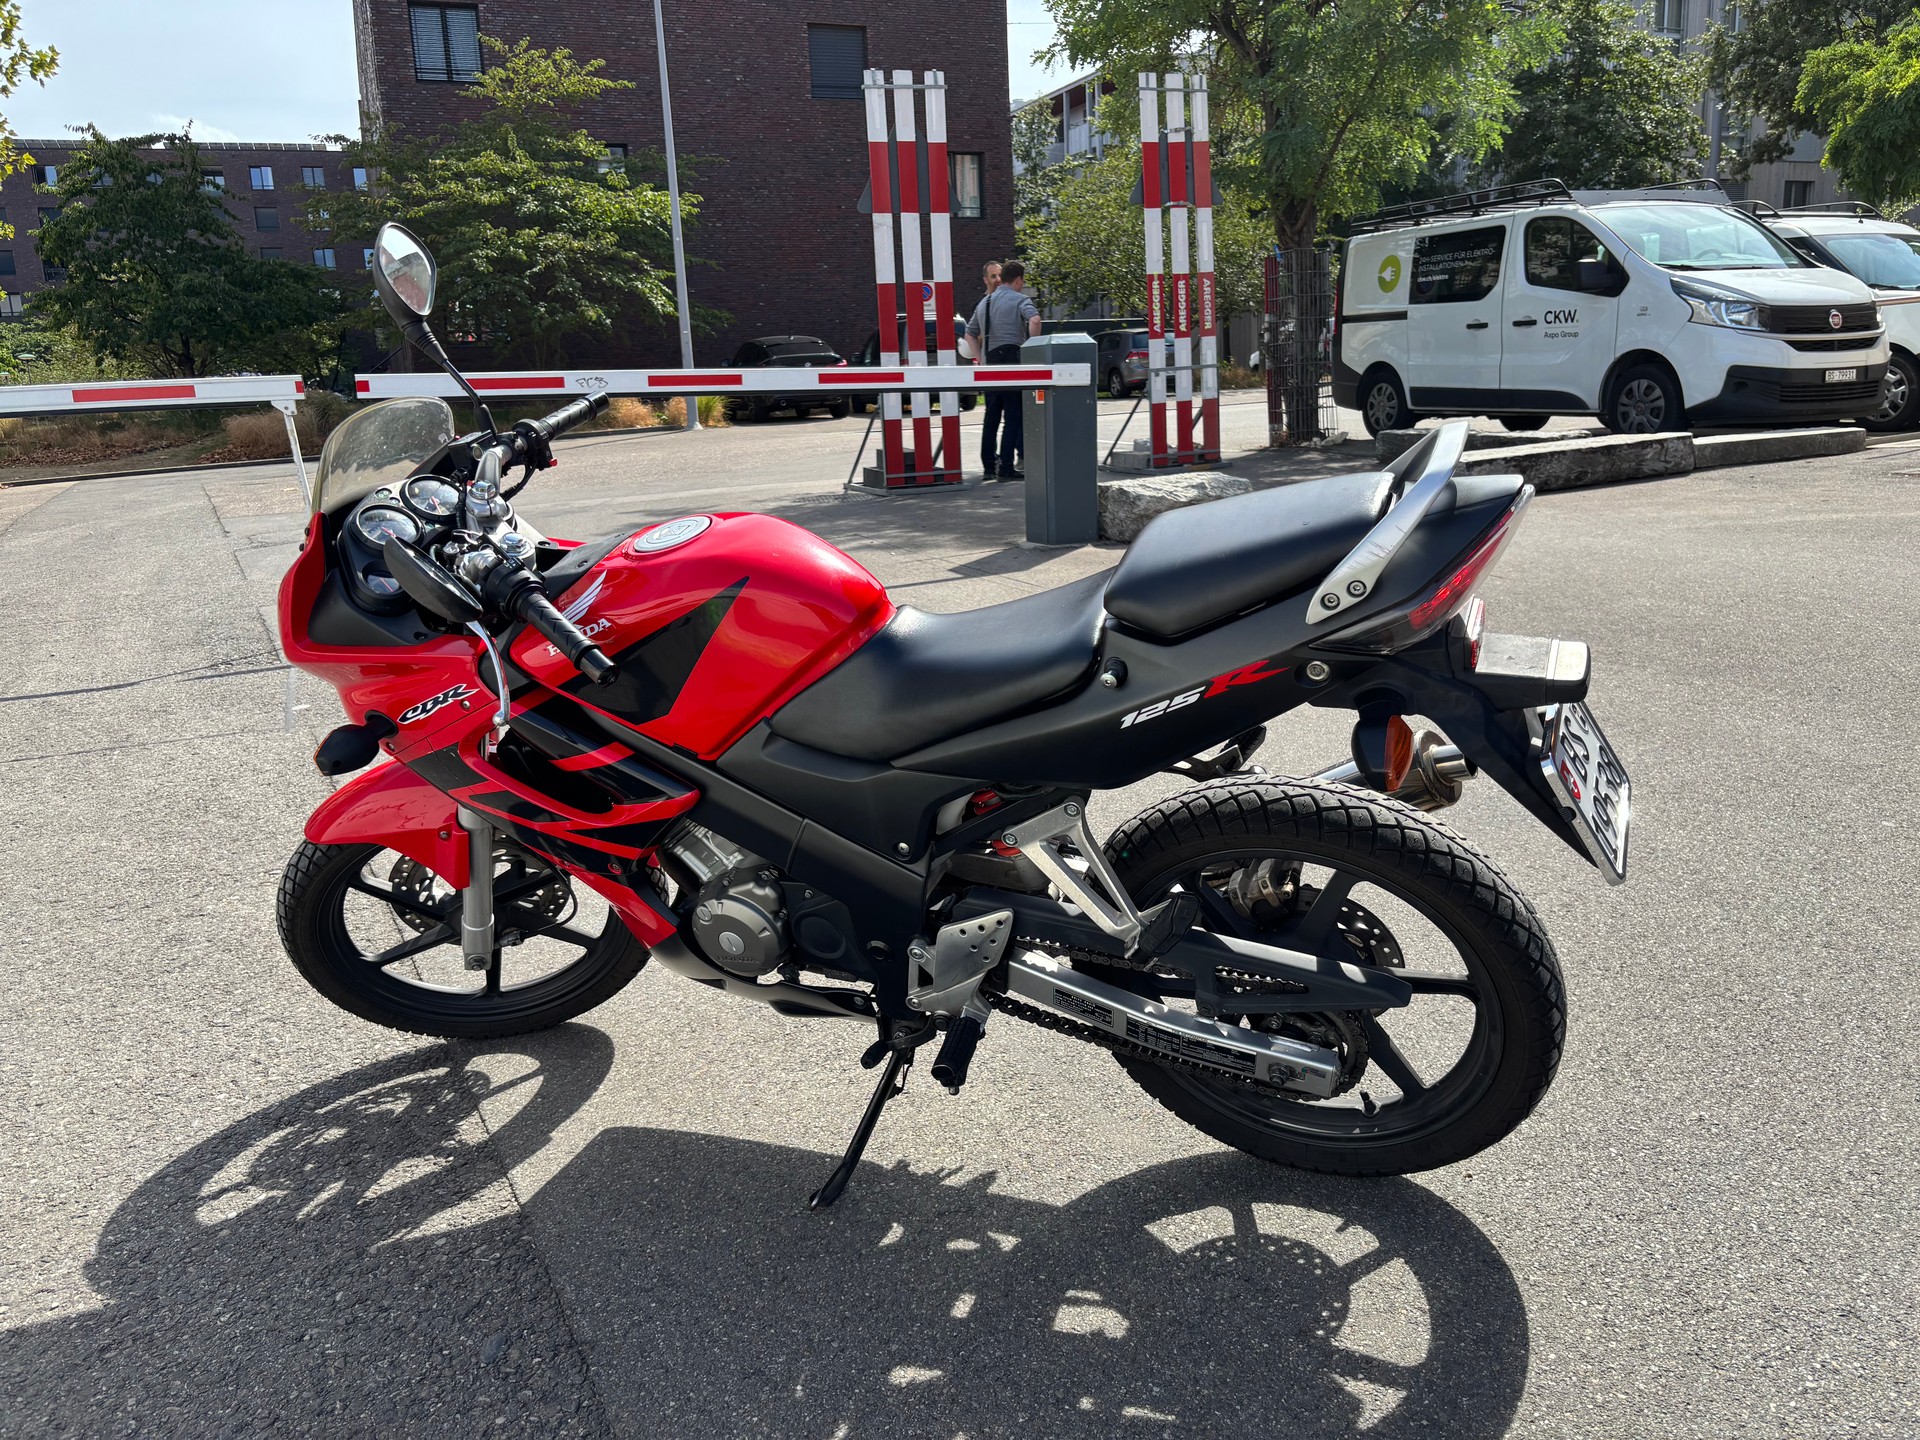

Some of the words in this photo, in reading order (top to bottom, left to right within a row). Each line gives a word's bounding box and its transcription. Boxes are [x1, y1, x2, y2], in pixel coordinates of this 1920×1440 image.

[1152, 280, 1161, 333] AREGGER
[1178, 279, 1187, 332] AREGGER
[1203, 278, 1212, 330] AREGGER
[1560, 330, 1579, 339] Group
